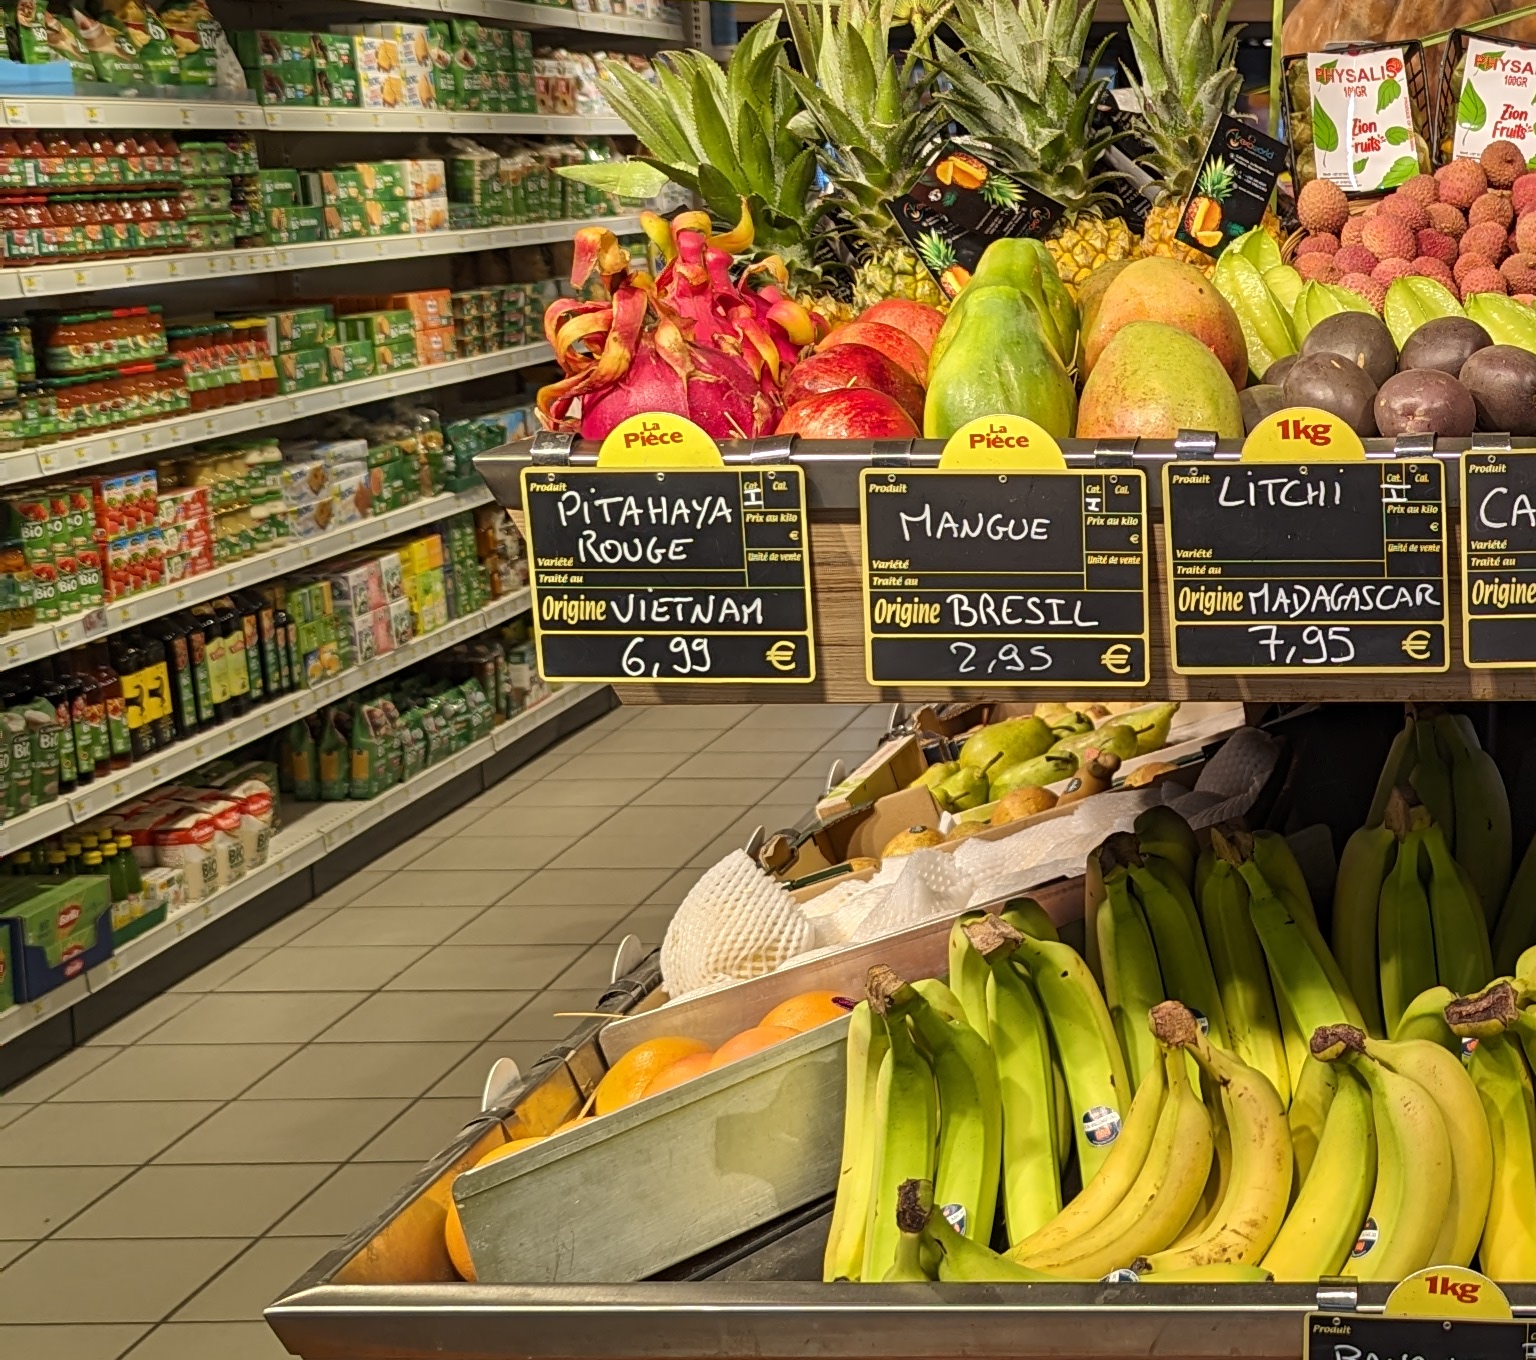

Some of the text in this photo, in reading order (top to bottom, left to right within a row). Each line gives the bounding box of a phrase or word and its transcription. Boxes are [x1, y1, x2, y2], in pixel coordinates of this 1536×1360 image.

[1315, 64, 1398, 84] PHYSALIS
[1504, 74, 1528, 88] 100GR
[1500, 103, 1529, 121] Zion
[1491, 120, 1527, 140] Fruits
[1351, 135, 1381, 154] ruits
[642, 422, 661, 432] La
[989, 424, 1008, 434] La
[1276, 418, 1333, 447] 1kg
[623, 430, 684, 449] Pièce
[969, 433, 1030, 450] Pièce
[1468, 464, 1507, 474] Produit
[530, 482, 567, 493] Produit
[1172, 474, 1211, 485] Produit
[1218, 468, 1345, 508] LITCHI
[869, 484, 907, 494] Produit
[557, 487, 733, 530] PITAHAYA
[1387, 504, 1439, 514] Prix au kilo
[899, 503, 1052, 542] MANGUE
[1086, 516, 1139, 526] Prix au kilo
[578, 530, 694, 564] ROUGE
[1176, 548, 1213, 558] Variété
[1470, 539, 1508, 550] Variété
[537, 557, 574, 567] Variété
[872, 559, 910, 569] Variété
[1176, 565, 1222, 575] Traité au
[1470, 557, 1516, 567] Traité au
[872, 575, 919, 586] Traité au
[542, 587, 764, 625] Origine VIETNAM
[1178, 582, 1442, 618] Origine MADAGASCAR
[874, 592, 1099, 628] Origine BRESIL
[1248, 625, 1432, 665] 7,95 €
[621, 637, 796, 678] 6,99 €
[949, 641, 1132, 674] 2,95 €
[1424, 1275, 1482, 1305] 1kg
[1312, 1324, 1352, 1335] Produit
